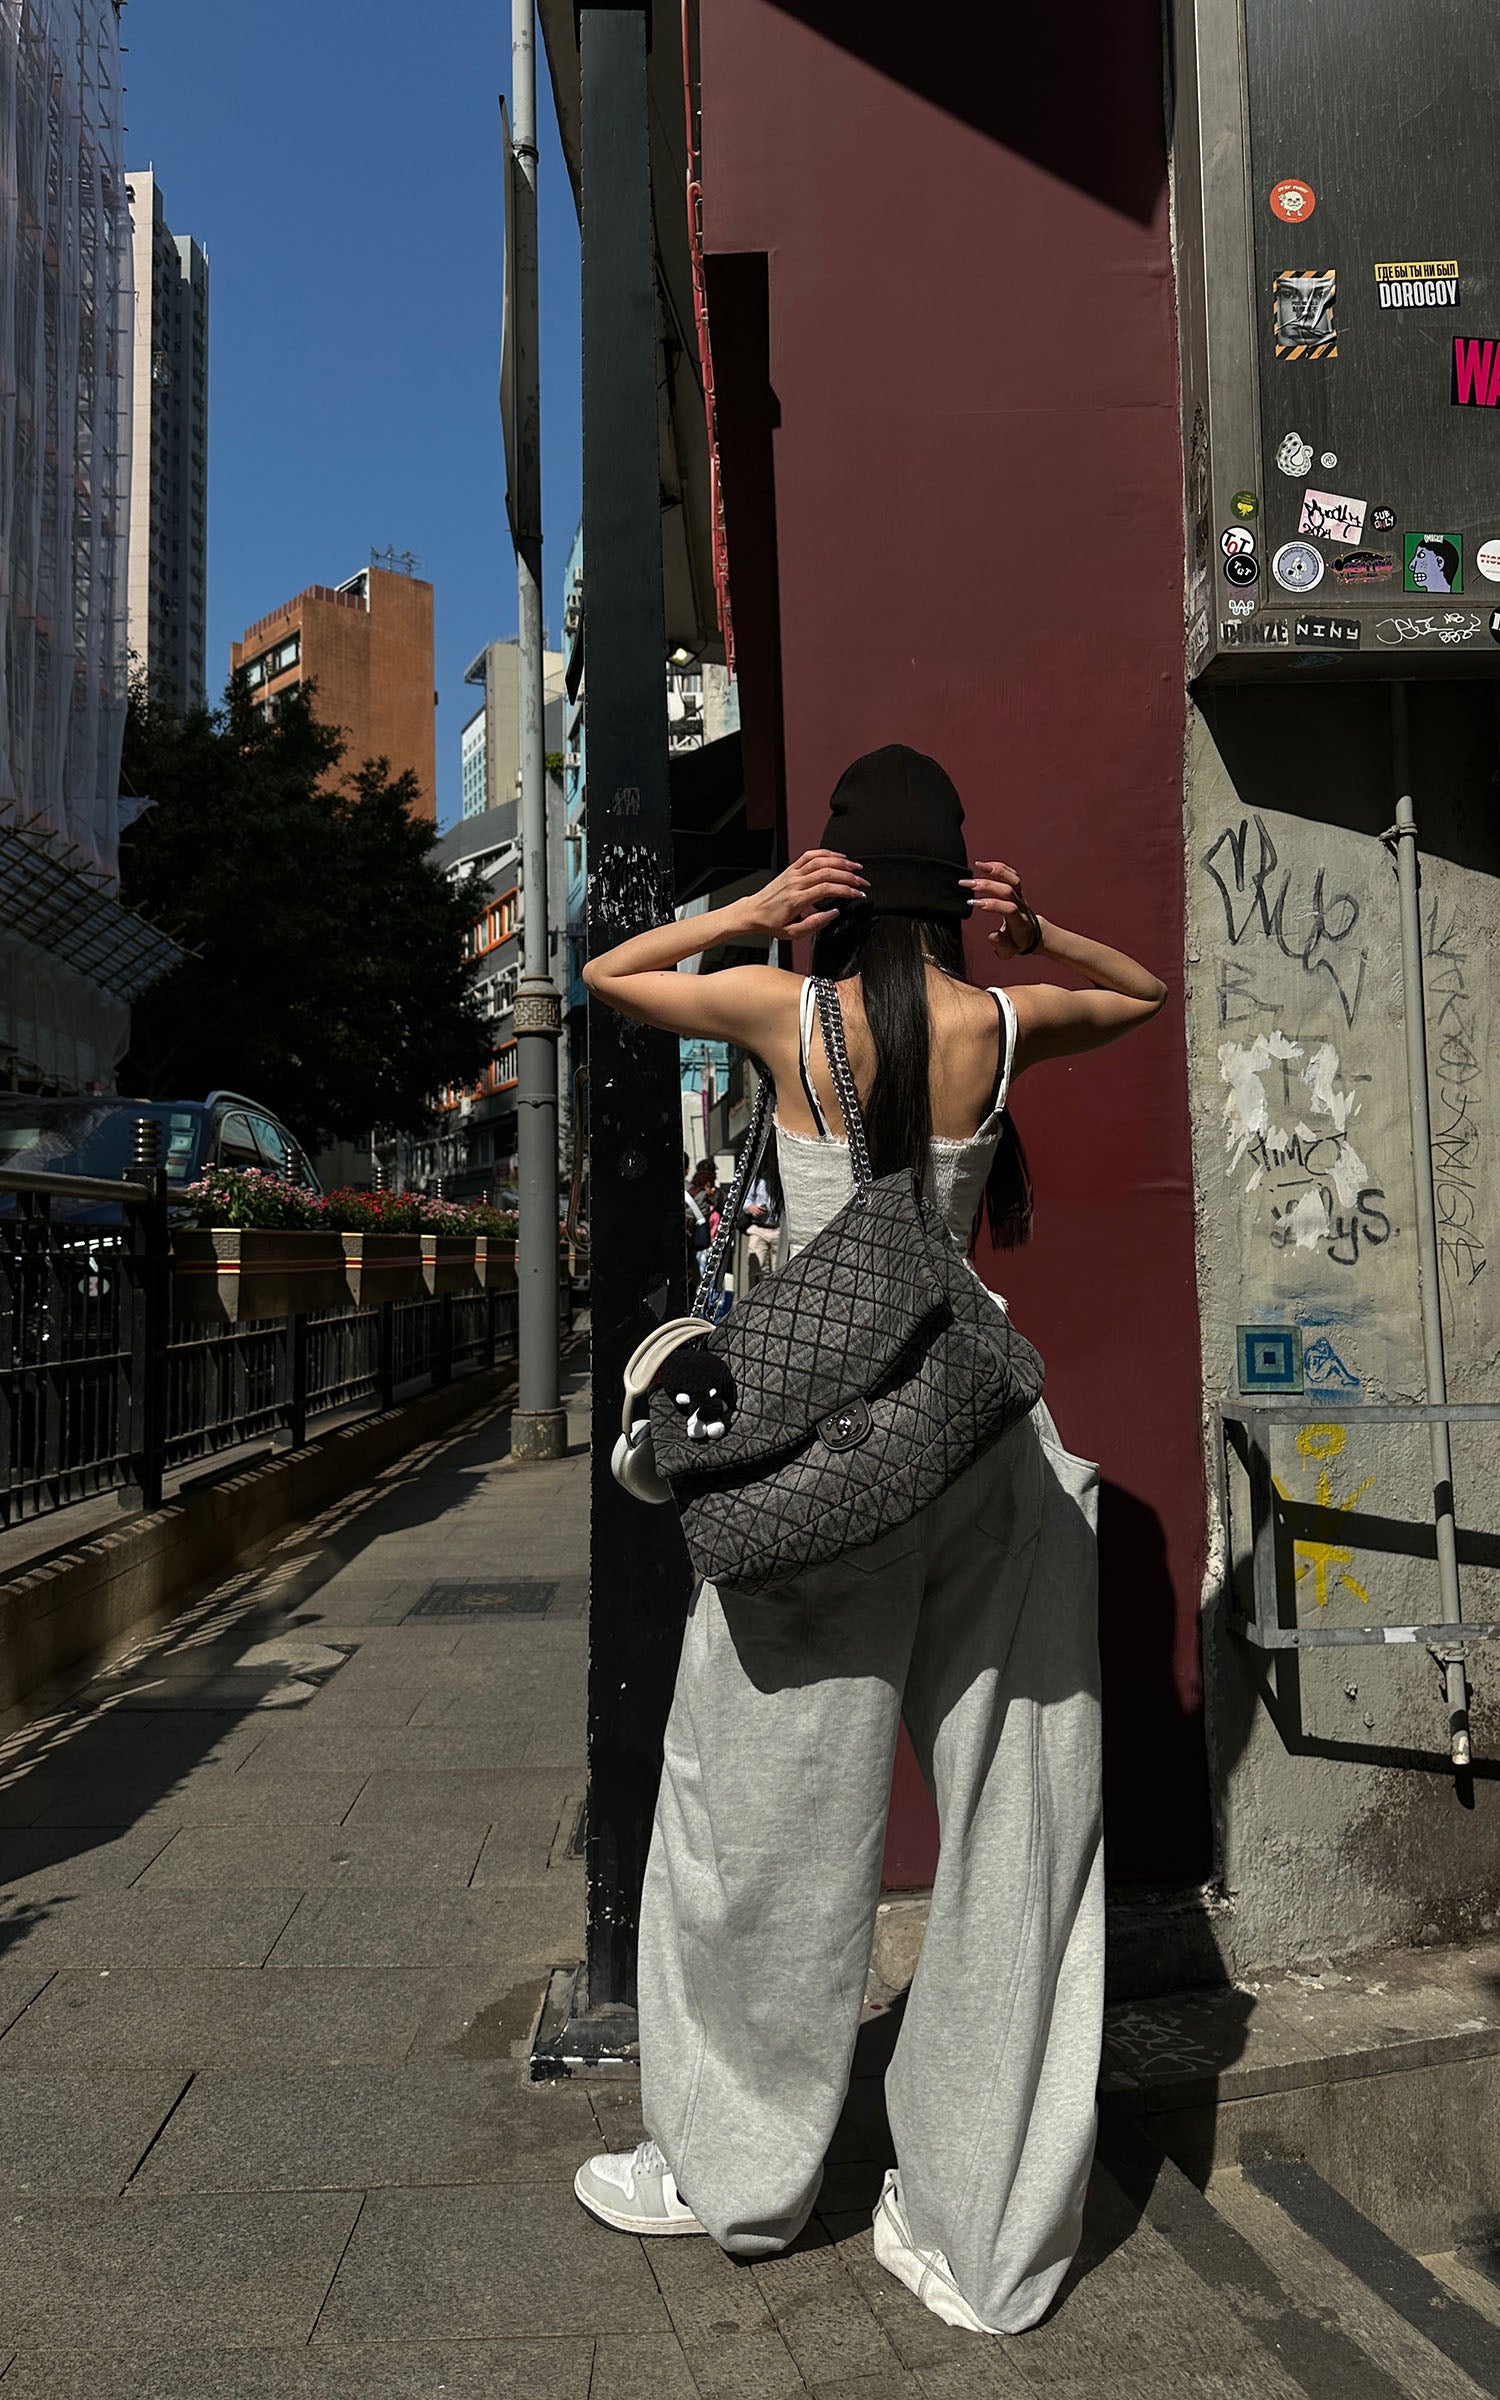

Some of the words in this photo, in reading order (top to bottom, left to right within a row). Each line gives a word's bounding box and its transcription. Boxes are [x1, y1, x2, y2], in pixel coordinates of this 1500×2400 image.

[1378, 266, 1394, 281] ГДЕ
[1394, 265, 1408, 278] БЫ
[1409, 265, 1422, 278] ТЫ
[1423, 264, 1436, 277] НИ
[1436, 263, 1456, 276] БЫЛ
[1379, 280, 1457, 308] DOROGOY
[1374, 509, 1391, 520] SUB
